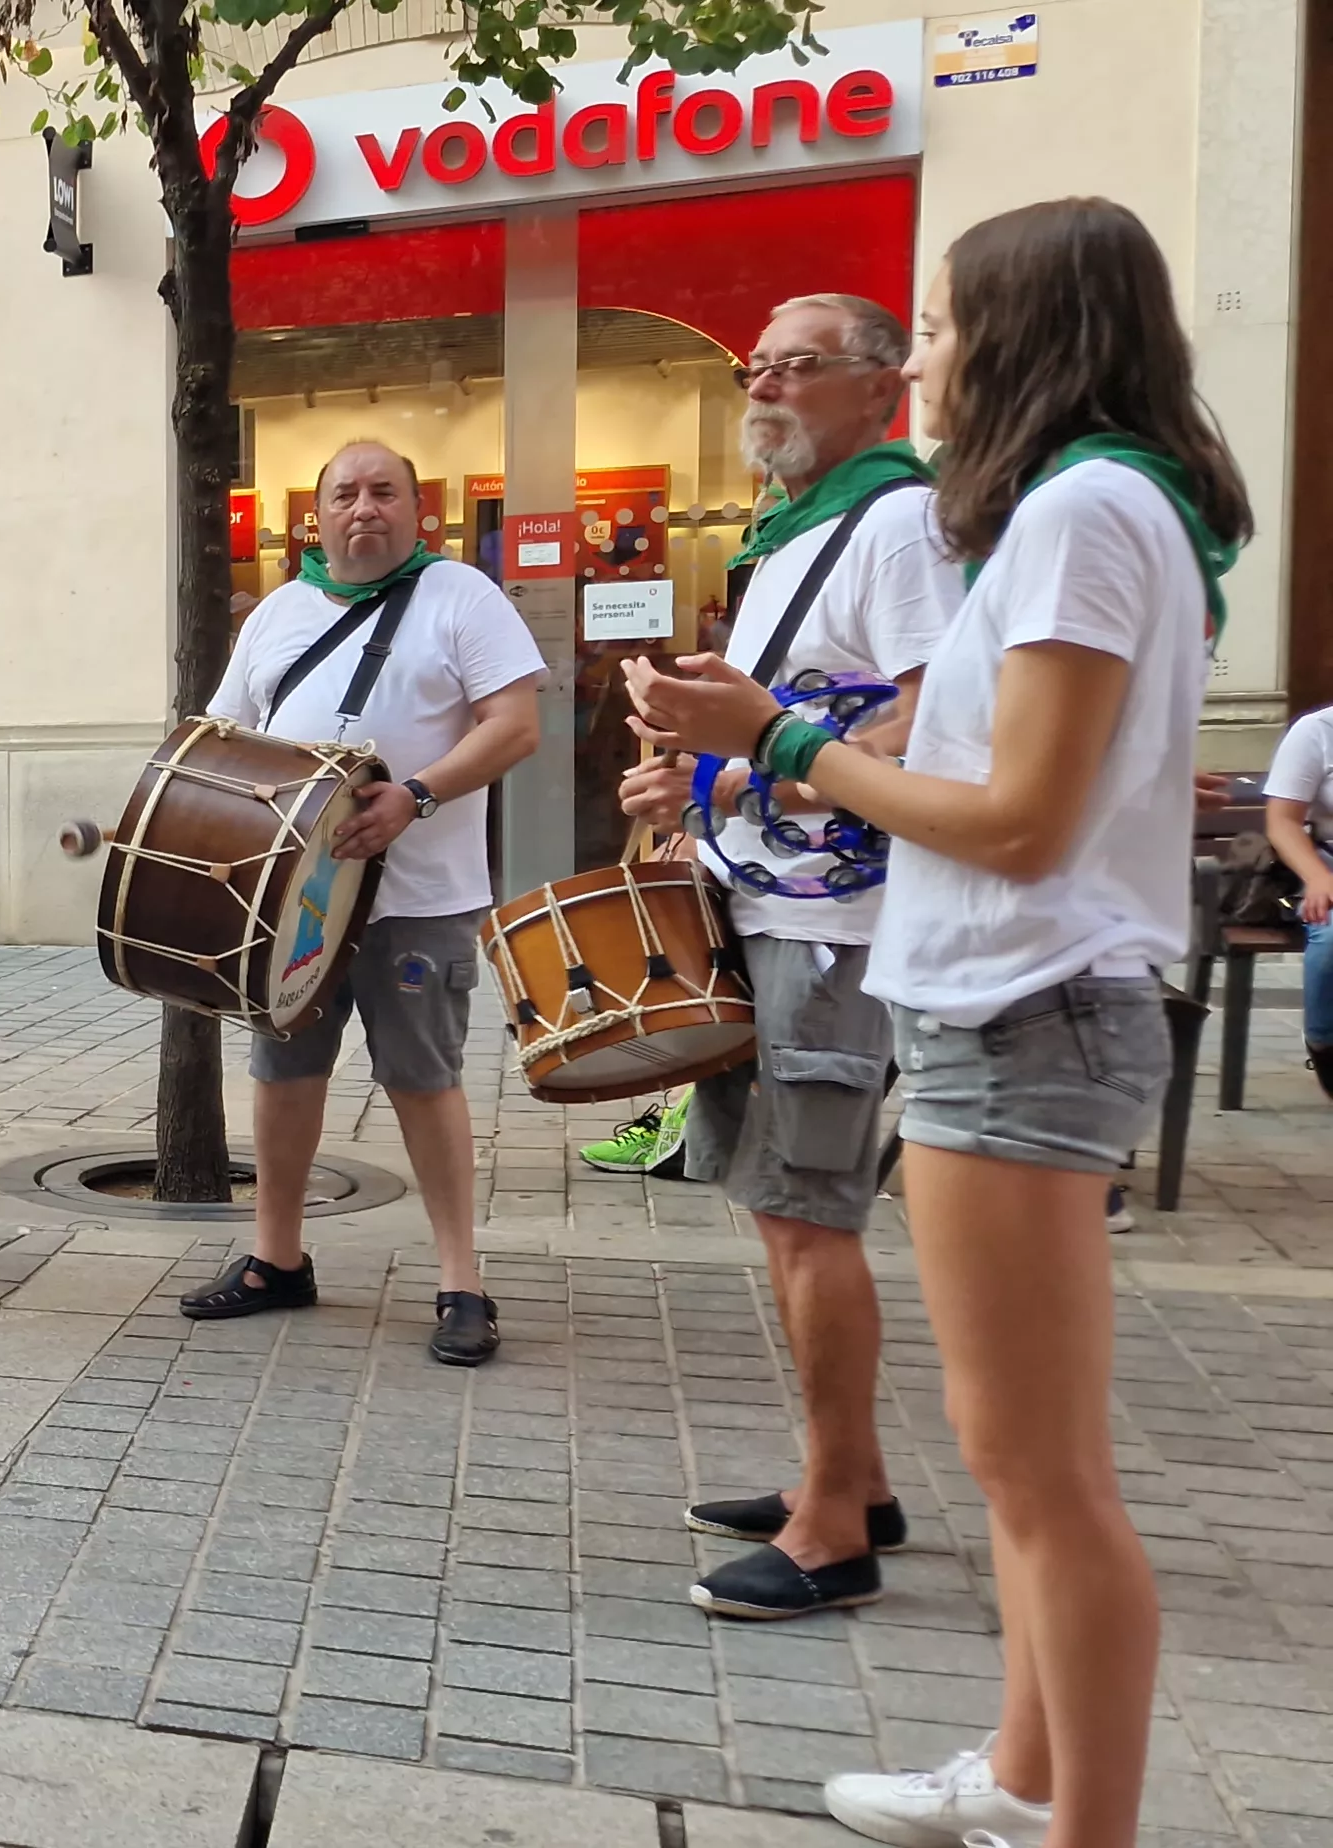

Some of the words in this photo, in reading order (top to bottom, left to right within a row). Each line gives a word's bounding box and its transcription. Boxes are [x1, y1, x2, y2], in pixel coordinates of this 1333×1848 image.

[951, 73, 972, 84] 902
[974, 71, 995, 81] 116
[354, 69, 894, 191] vodafone
[471, 480, 504, 492] Autón
[518, 519, 561, 538] ¡Hola!
[592, 603, 604, 611] Se
[605, 601, 646, 610] necesita
[592, 610, 634, 621] personal
